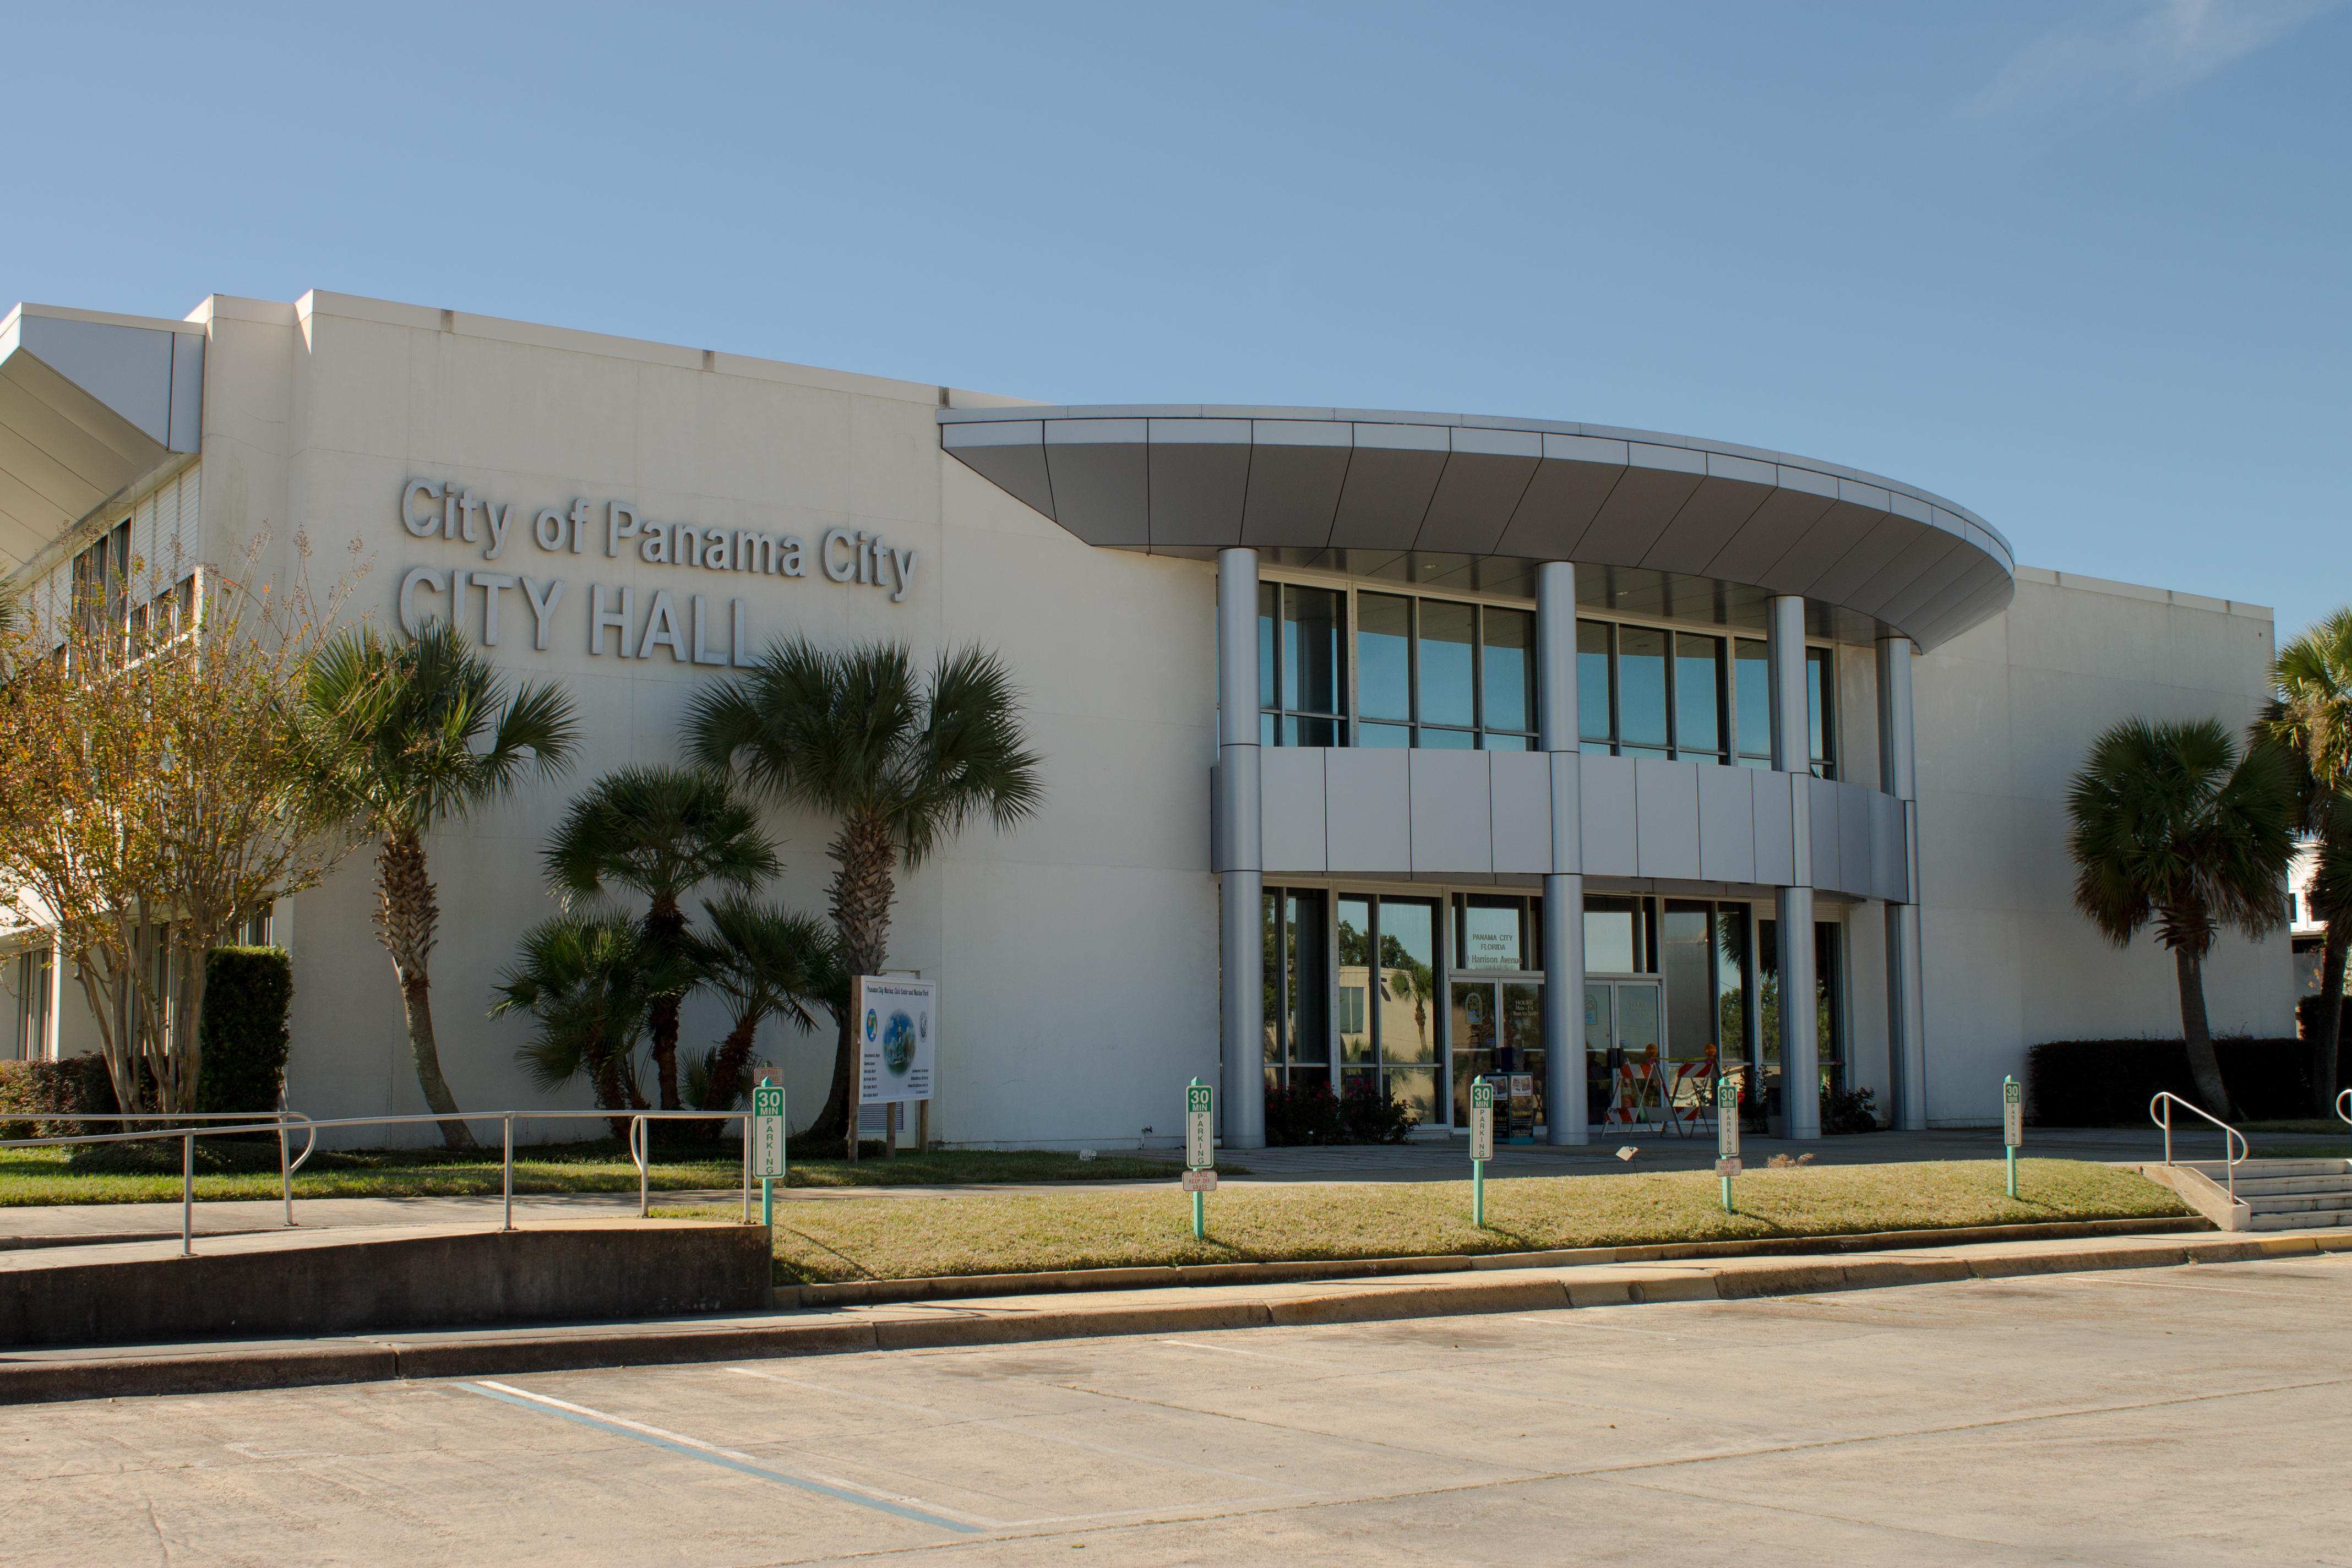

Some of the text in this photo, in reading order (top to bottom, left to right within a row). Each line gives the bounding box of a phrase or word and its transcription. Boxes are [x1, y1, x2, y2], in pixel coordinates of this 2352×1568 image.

[401, 477, 919, 603] City of Panama City
[399, 567, 766, 668] CITY HALL
[1472, 955, 1498, 963] Harrison
[1500, 955, 1522, 964] Avenue
[1470, 1003, 1479, 1011] Hall
[1190, 1090, 1209, 1104] 30
[1474, 1088, 1490, 1101] 30
[1721, 1089, 1734, 1101] 30
[2006, 1086, 2018, 1096] 30
[758, 1092, 781, 1107] 30
[760, 1107, 778, 1115] MIN
